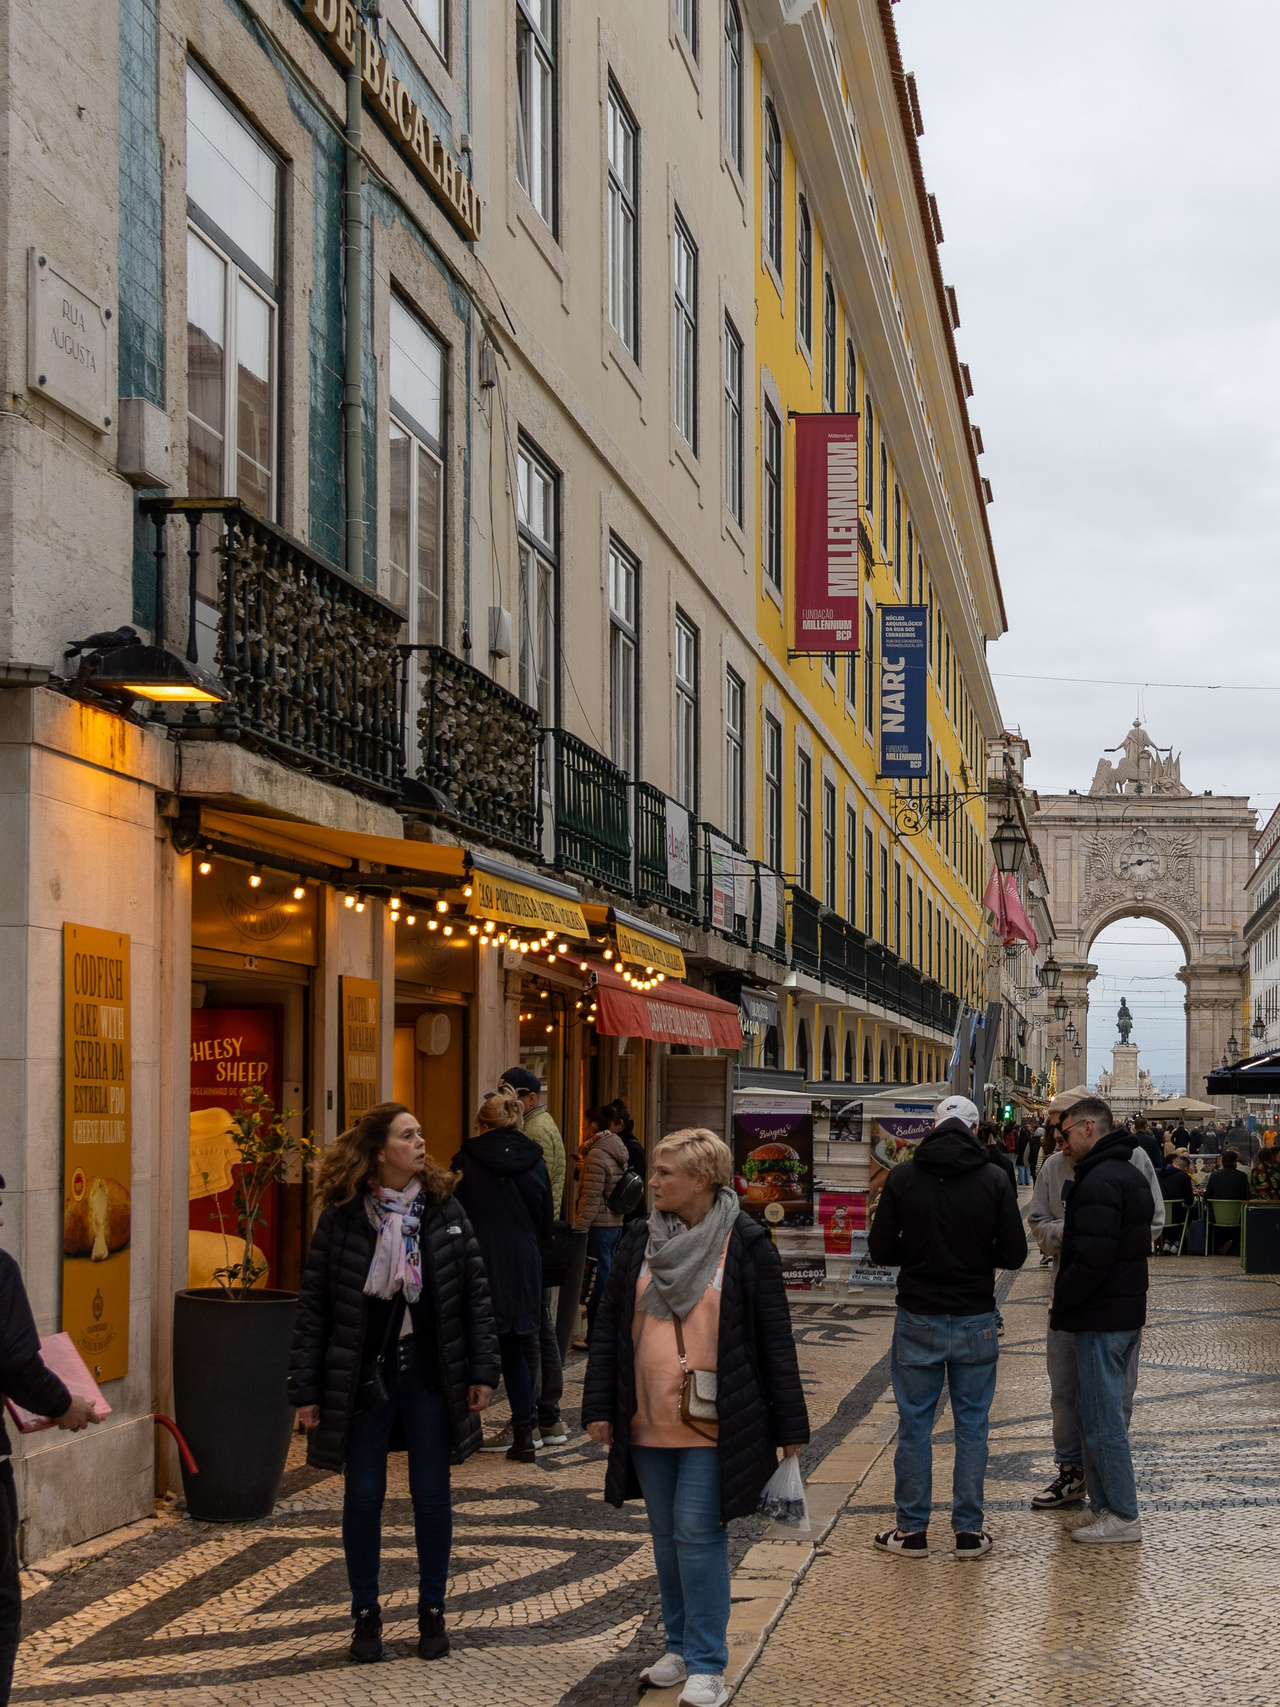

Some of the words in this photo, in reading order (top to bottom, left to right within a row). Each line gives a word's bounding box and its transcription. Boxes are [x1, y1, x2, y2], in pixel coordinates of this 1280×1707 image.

[361, 22, 484, 241] BACALHAU
[62, 299, 86, 333] RUA
[51, 327, 97, 374] AUGUSTA
[827, 441, 858, 597] MILLENNIUM
[802, 608, 834, 621] FUNDAÇÃO
[802, 620, 852, 630] MILLENNIUM
[836, 630, 852, 641] BCP
[882, 656, 906, 733] NARC
[885, 745, 909, 753] FUNDAÇÃO
[910, 761, 922, 769] BCP
[495, 887, 538, 919] PORTUGUESA
[74, 952, 124, 1001] CODFISH
[74, 1002, 98, 1037] CAKE
[100, 1005, 125, 1040] WITH
[347, 995, 368, 1023] PASTEL
[74, 1040, 110, 1081] SERRA
[111, 1043, 125, 1081] DA
[216, 1061, 269, 1082] SHEEP
[74, 1085, 108, 1114] ESTRELA
[110, 1086, 125, 1114] PDO
[73, 1119, 99, 1144] CHEESE
[100, 1120, 126, 1144] FILLING
[759, 1127, 788, 1140] Burgers
[896, 1123, 931, 1137] Salads
